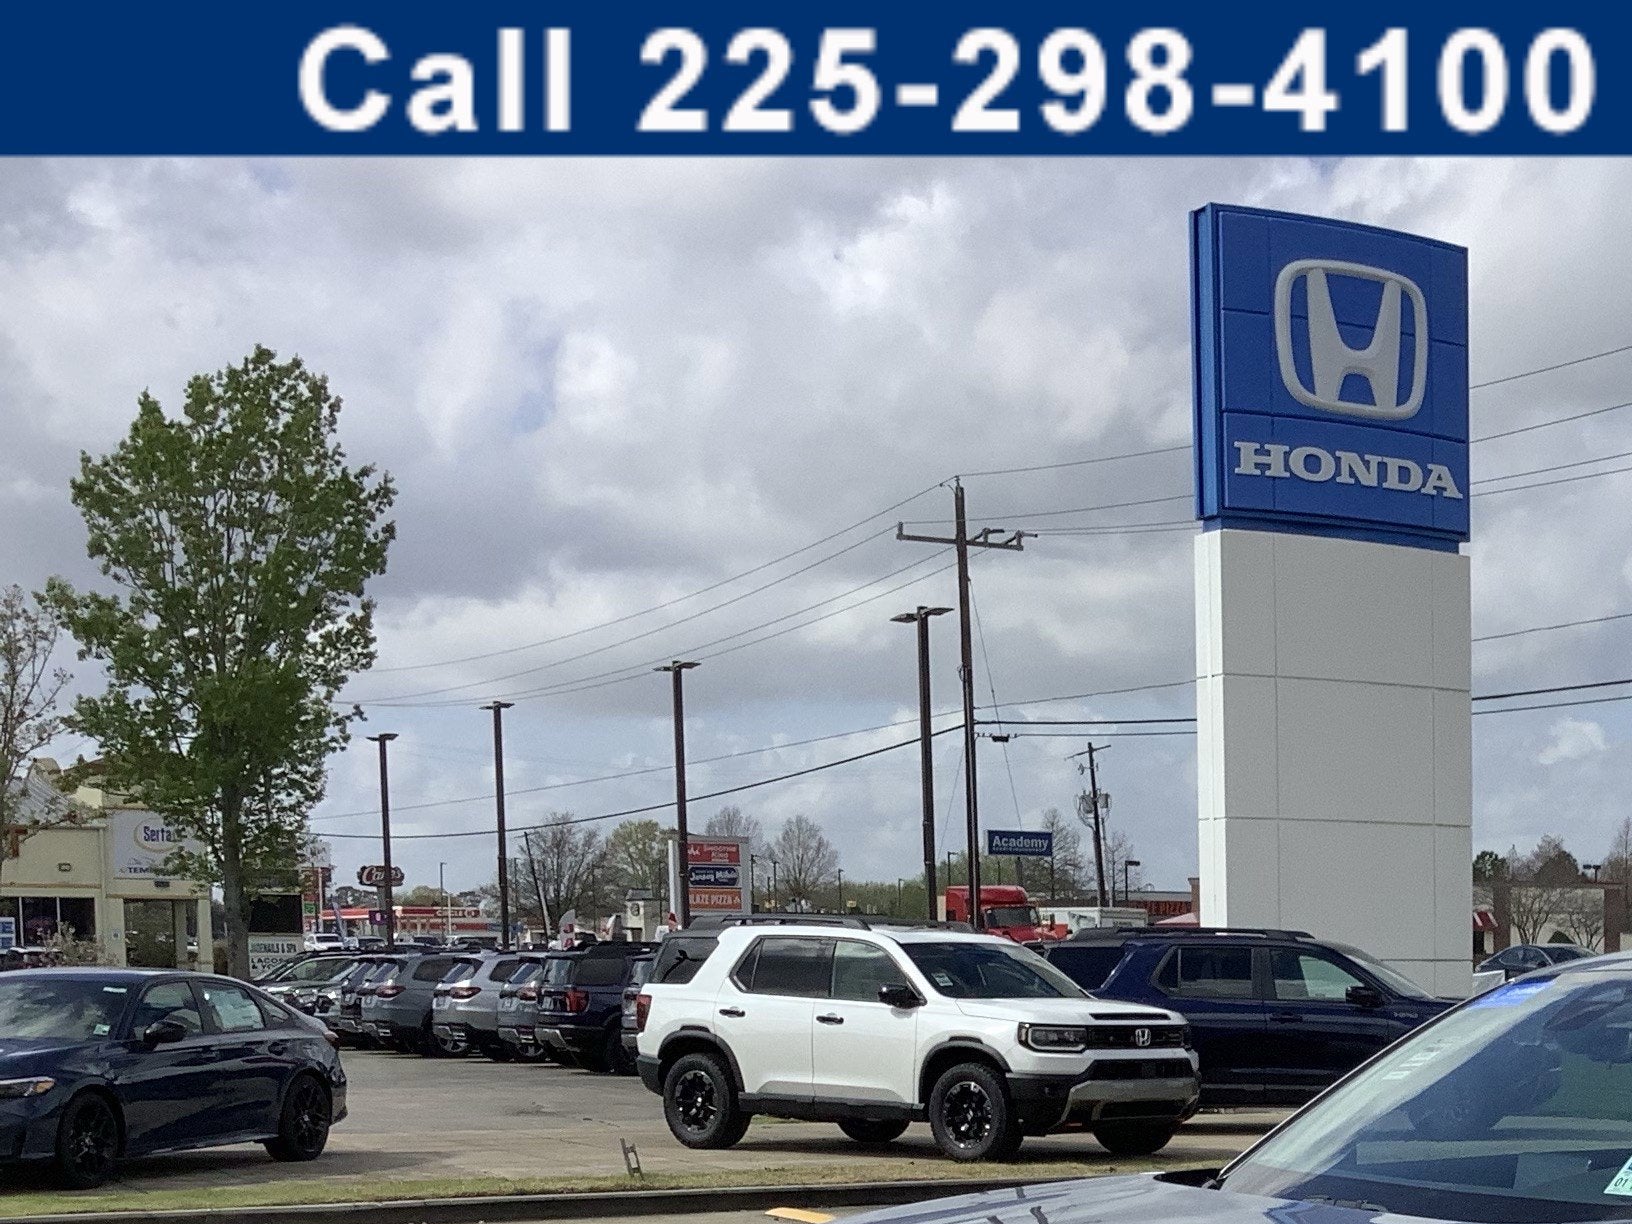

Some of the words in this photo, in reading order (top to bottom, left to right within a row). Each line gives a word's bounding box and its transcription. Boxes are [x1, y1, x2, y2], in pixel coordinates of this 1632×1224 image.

[1234, 441, 1464, 500] HONDA
[143, 825, 173, 842] Serta
[992, 835, 1049, 851] Academy
[1614, 1177, 1628, 1188] 01
